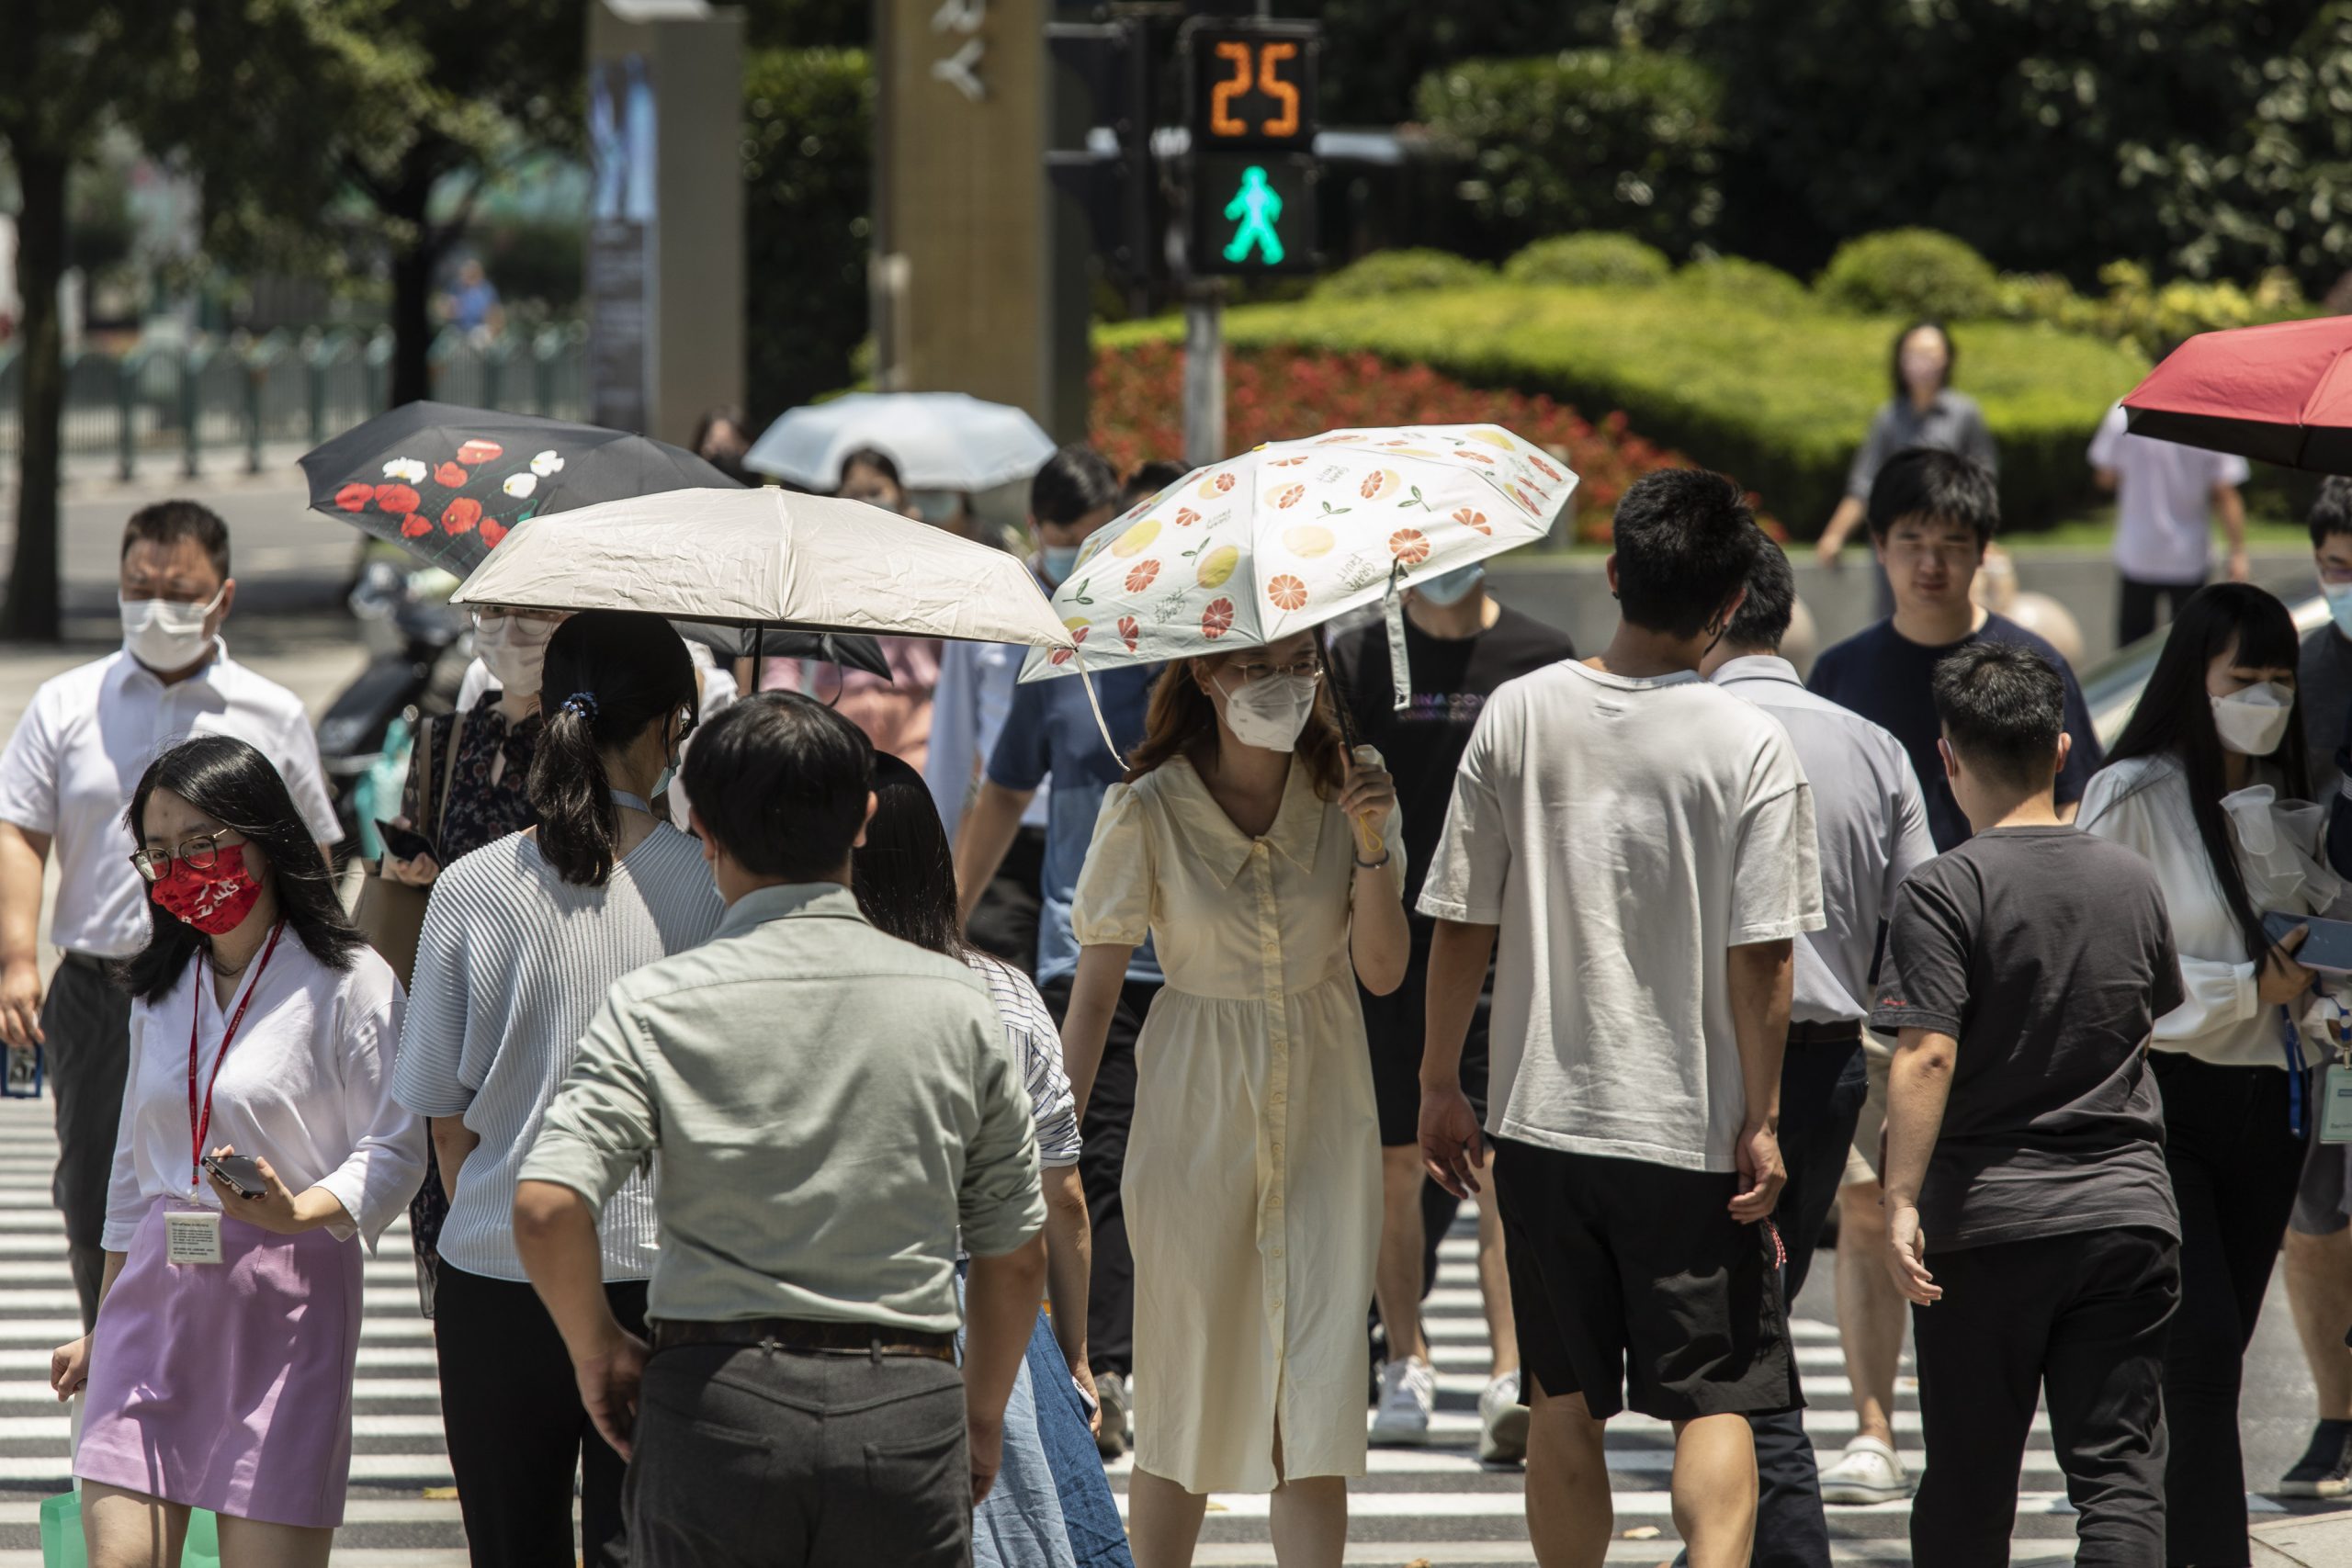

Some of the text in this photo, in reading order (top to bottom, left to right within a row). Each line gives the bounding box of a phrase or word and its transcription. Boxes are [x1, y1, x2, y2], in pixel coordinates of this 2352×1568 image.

[1212, 41, 1299, 137] 25
[1336, 553, 1363, 581] FRUIT
[1345, 562, 1374, 591] GRAPE
